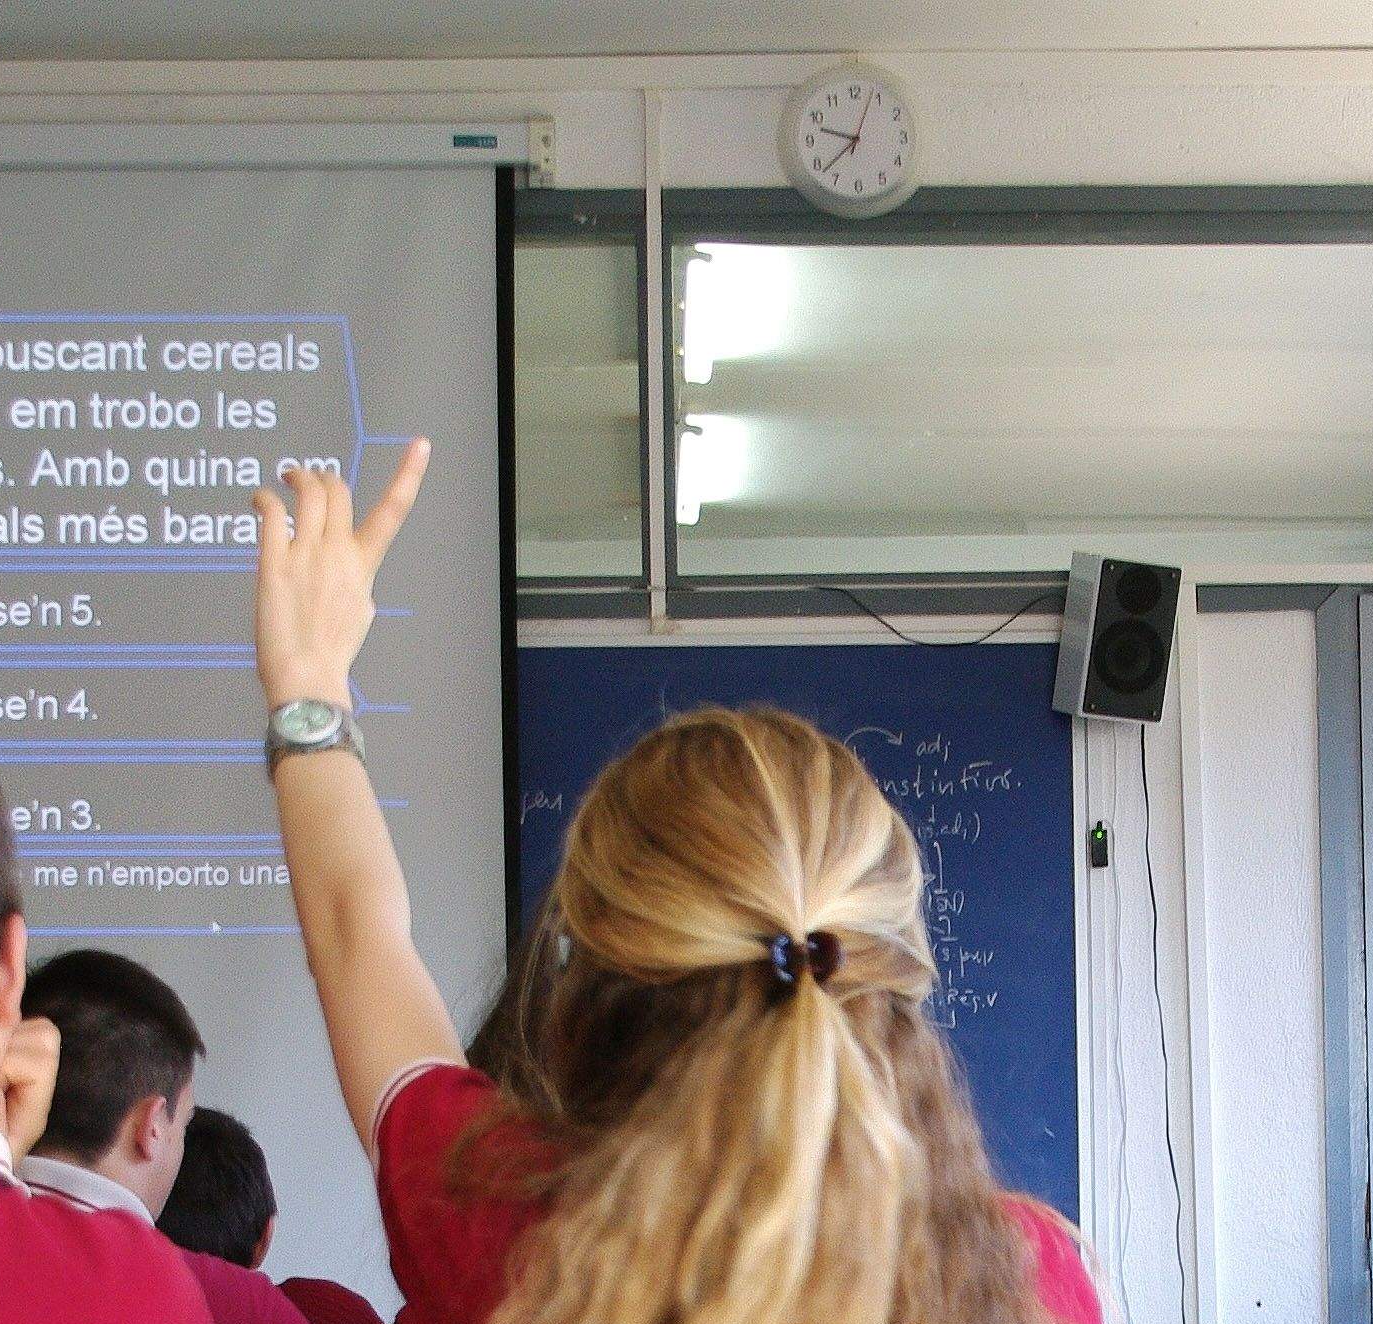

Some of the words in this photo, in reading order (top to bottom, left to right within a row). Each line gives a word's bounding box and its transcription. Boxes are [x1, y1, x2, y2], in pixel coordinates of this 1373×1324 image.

[848, 84, 861, 100] 12
[827, 93, 839, 108] 11
[810, 110, 824, 125] 10
[891, 106, 902, 122] 2
[804, 133, 815, 149] 9
[899, 130, 909, 146] 3
[893, 154, 902, 168] 4
[831, 172, 840, 187] 7
[853, 178, 864, 194] 6
[878, 171, 887, 186] 5
[161, 332, 321, 372] cereals
[9, 398, 77, 430] em
[88, 391, 202, 430] trobo
[216, 391, 278, 430] les
[29, 448, 131, 488] Amb
[143, 449, 263, 496] quina
[57, 504, 149, 545] més
[163, 506, 295, 545] bara
[70, 593, 103, 628] 5.
[65, 688, 99, 721] 4.
[70, 799, 102, 832] 3.
[33, 865, 79, 887] me
[87, 860, 231, 892] n'emporto
[238, 864, 290, 887] una
